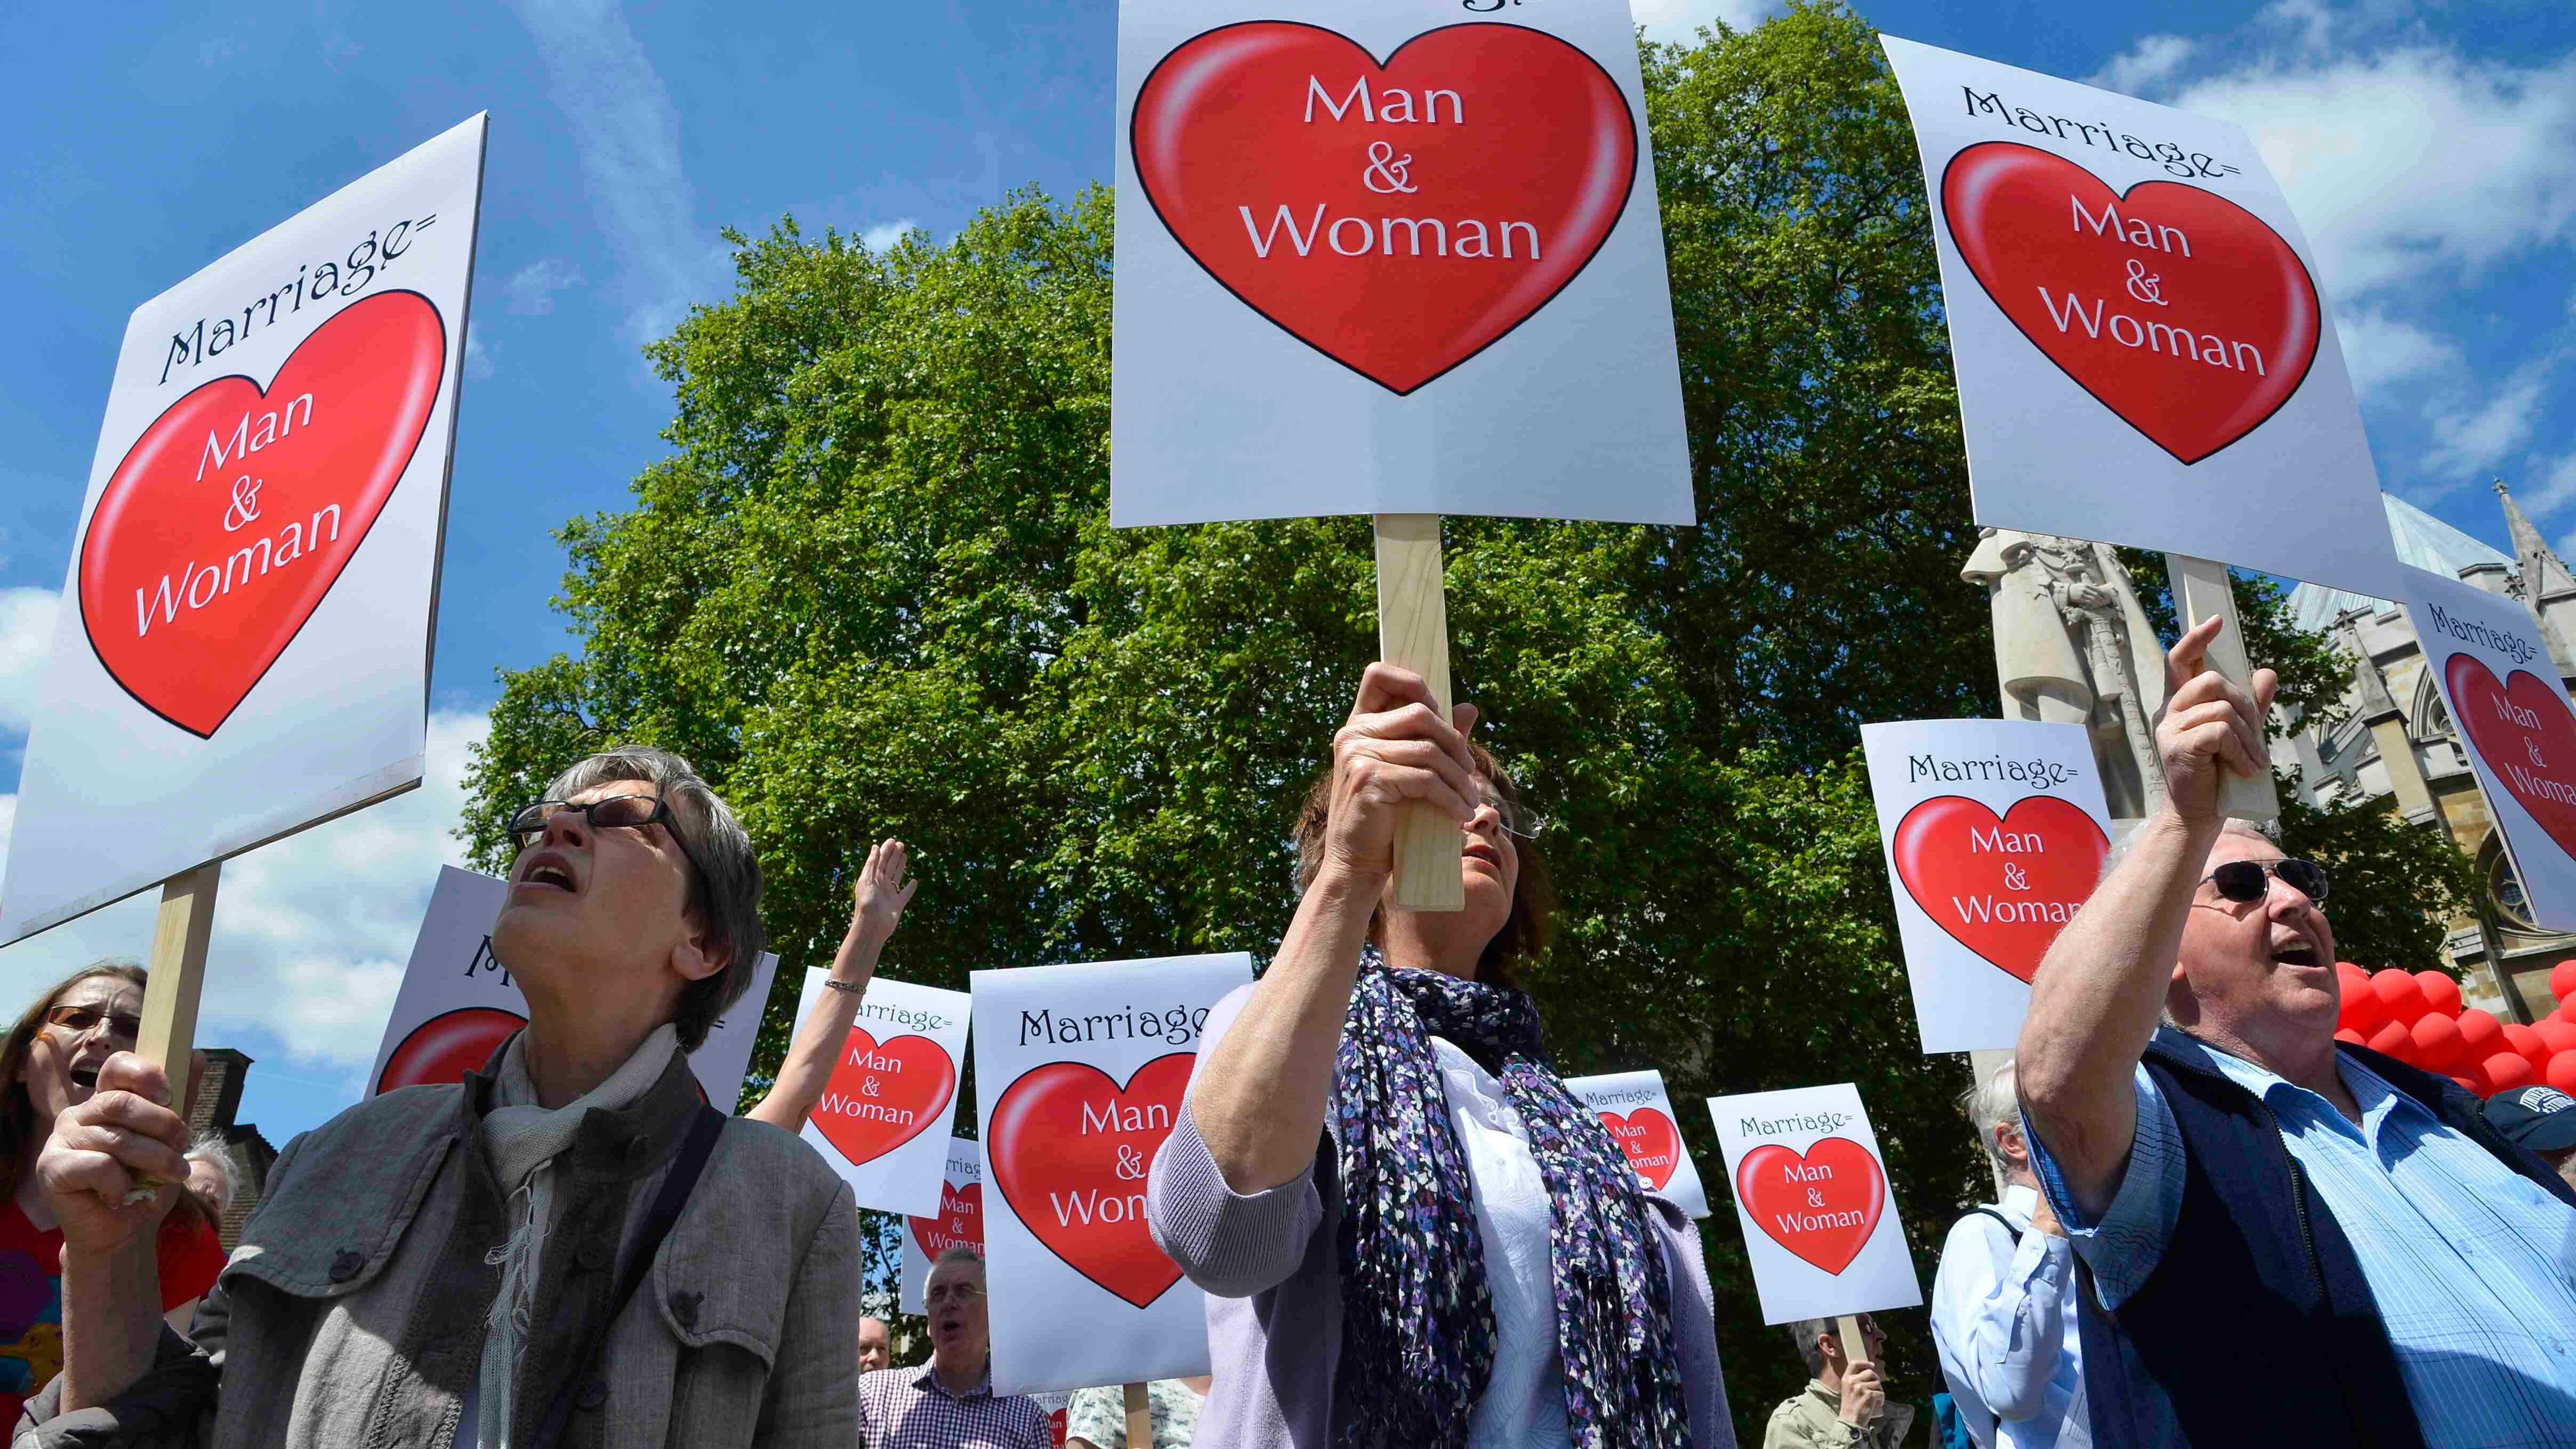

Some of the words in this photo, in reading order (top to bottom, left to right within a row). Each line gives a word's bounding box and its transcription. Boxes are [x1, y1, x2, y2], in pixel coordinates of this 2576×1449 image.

[1305, 74, 1463, 123] Man
[1961, 85, 2241, 179] Marriage=
[1363, 141, 1418, 194] &
[1238, 204, 1540, 260] Woman
[2070, 194, 2192, 258] Man
[158, 214, 436, 386] Marriage=
[2126, 259, 2169, 306] &
[2038, 286, 2266, 376] Woman
[195, 391, 314, 482] Man
[223, 474, 263, 532] &
[136, 503, 341, 638] Woman
[2428, 602, 2538, 664] Marriage=
[2491, 692, 2542, 730] Man
[2524, 736, 2547, 768] &
[1909, 754, 2079, 790] Marriage=
[2503, 762, 2576, 806] Woma
[1970, 825, 2044, 854] Man
[2005, 862, 2031, 890] &
[856, 1004, 953, 1032] arriage=
[1019, 1005, 1210, 1046] Marriage
[848, 1047, 902, 1074] Man
[862, 1075, 880, 1098] &
[820, 1092, 914, 1126] Woman
[1082, 1098, 1169, 1135] Man
[1740, 1112, 1854, 1137] Marriage=
[1614, 1124, 1647, 1138] Man
[1630, 1140, 1644, 1154] &
[1115, 1144, 1146, 1180] &
[1628, 1154, 1669, 1169] oman
[1783, 1162, 1833, 1184] Man
[941, 1195, 974, 1214] Man
[1807, 1187, 1825, 1208] &
[952, 1217, 964, 1234] &
[1776, 1210, 1865, 1234] Woman
